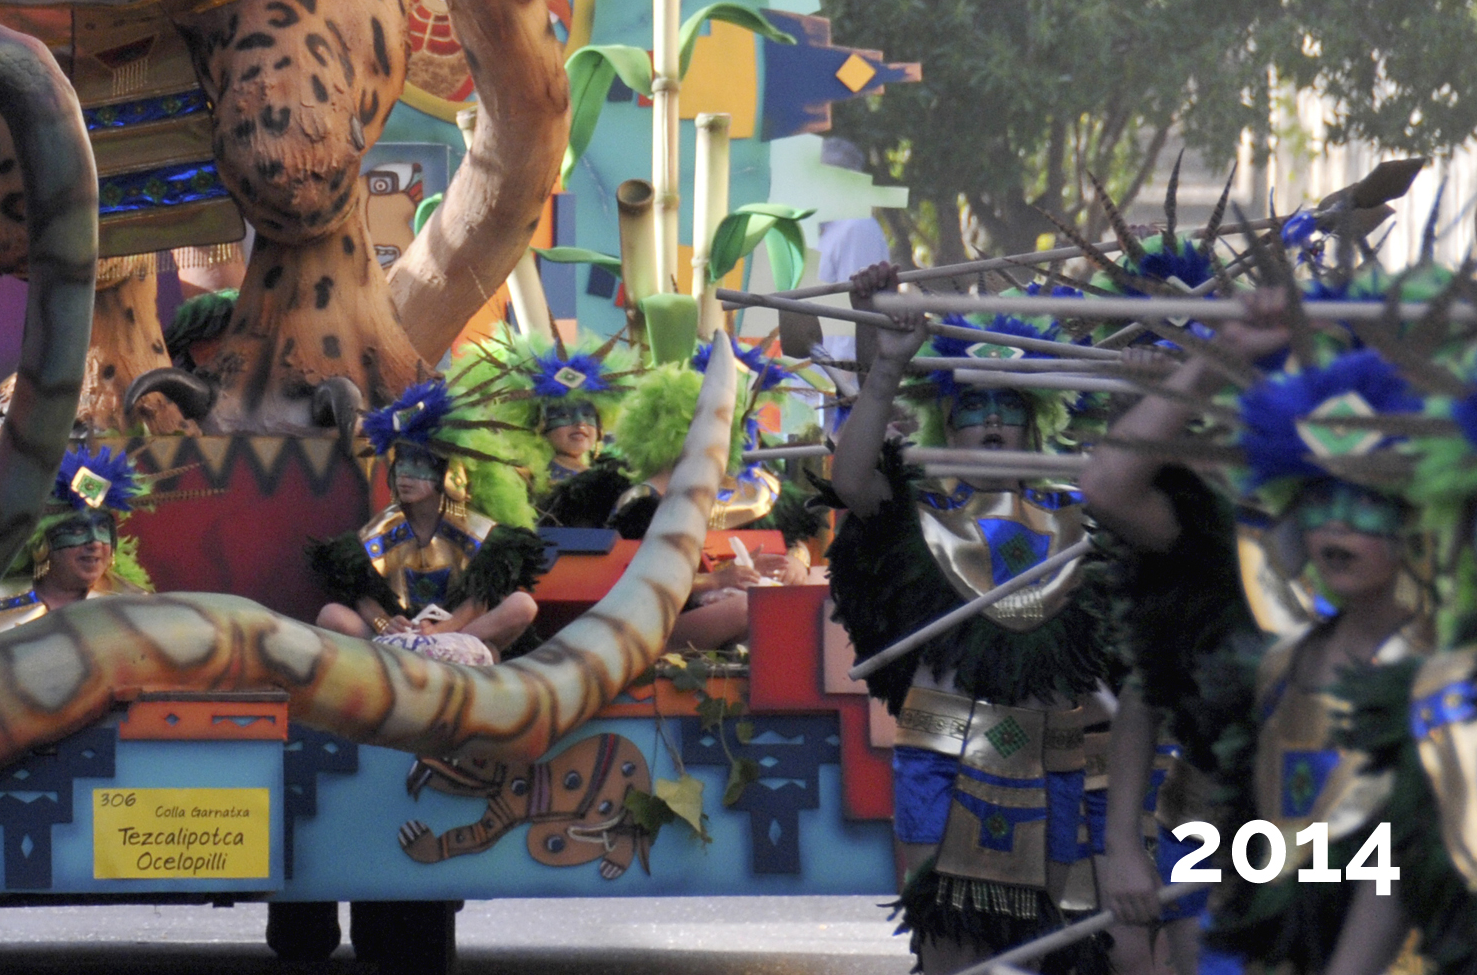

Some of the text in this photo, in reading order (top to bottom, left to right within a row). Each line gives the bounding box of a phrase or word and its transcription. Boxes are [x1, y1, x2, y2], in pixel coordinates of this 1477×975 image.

[101, 792, 136, 808] 306
[155, 805, 250, 818] Colla Garnatxa
[118, 826, 244, 850] Tezcalipotca
[136, 851, 228, 875] Ocelopilli
